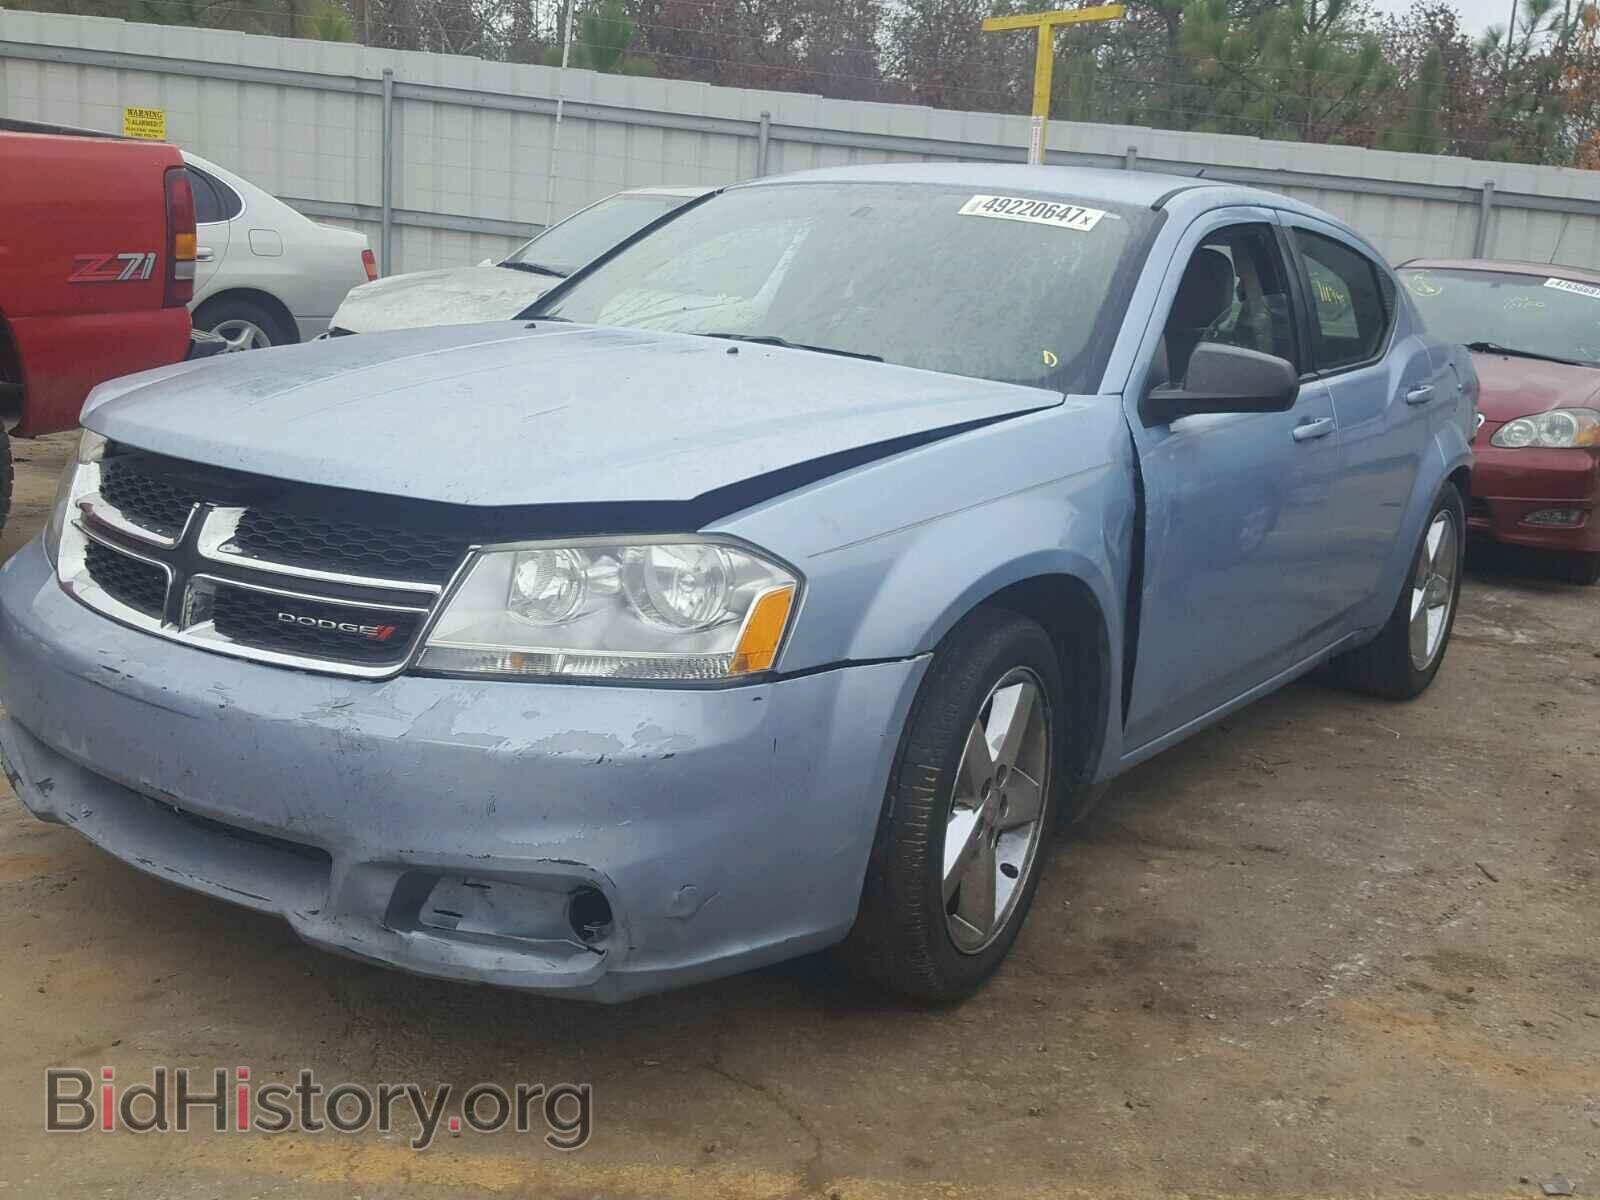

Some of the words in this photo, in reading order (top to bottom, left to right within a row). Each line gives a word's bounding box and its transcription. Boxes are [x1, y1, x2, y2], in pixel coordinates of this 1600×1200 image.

[127, 108, 163, 120] WARNING
[65, 252, 157, 282] Z71
[278, 612, 380, 637] DODGE
